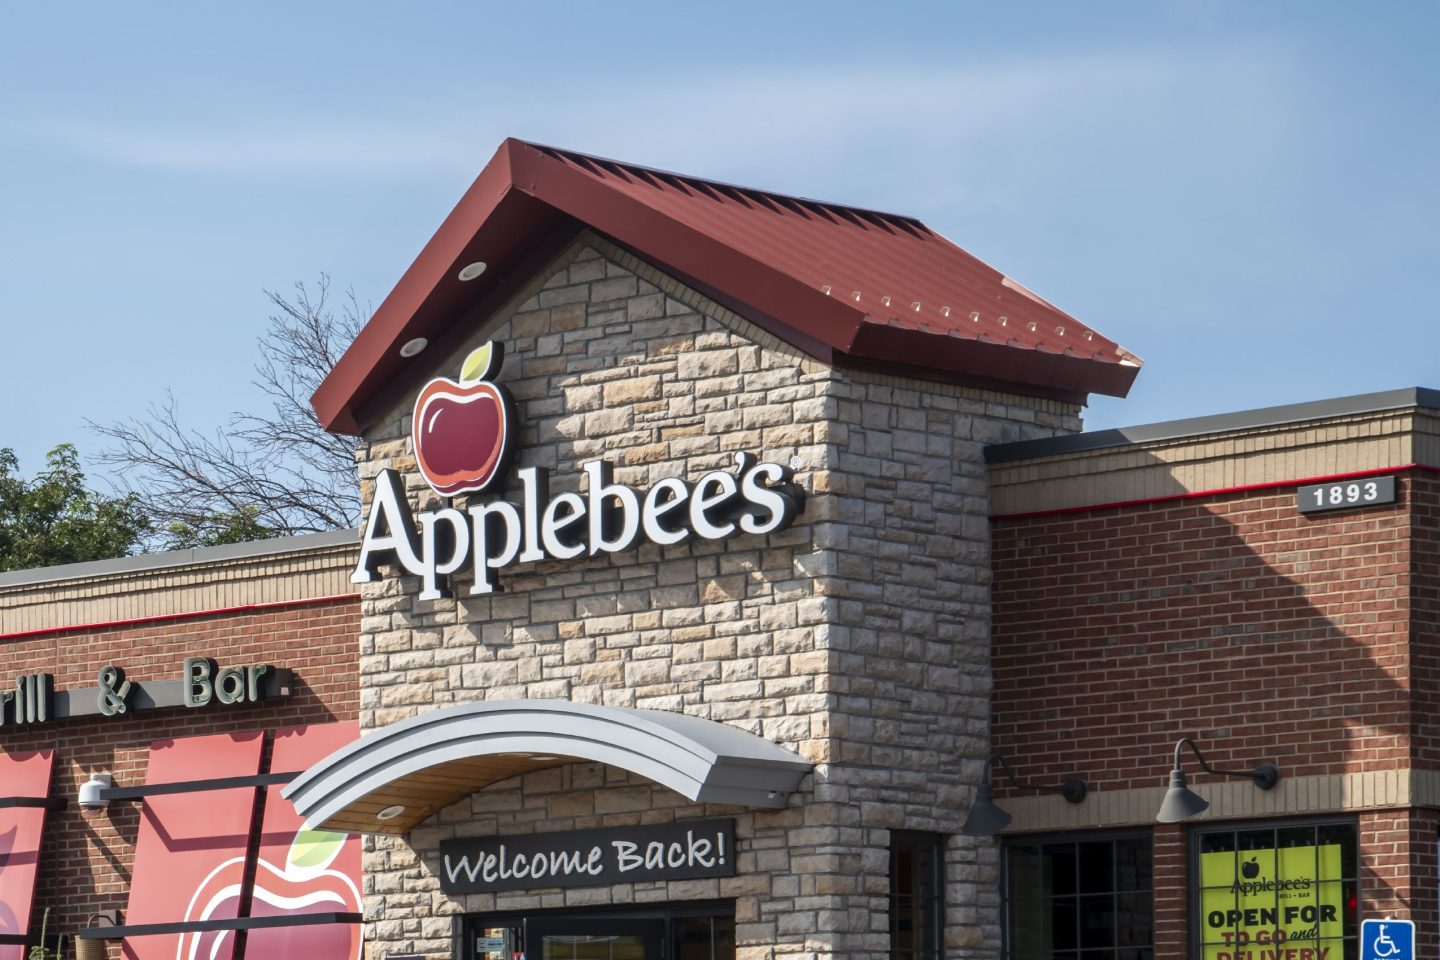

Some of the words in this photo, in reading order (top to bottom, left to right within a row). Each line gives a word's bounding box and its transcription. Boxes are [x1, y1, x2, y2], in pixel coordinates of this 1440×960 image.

[1313, 482, 1378, 506] 1893
[350, 451, 786, 600] Applebee's
[98, 665, 131, 716] &
[184, 656, 267, 707] Bar
[444, 844, 603, 884] Welcome
[611, 830, 726, 873] Back!
[1208, 908, 1277, 928] OPEN
[1284, 904, 1337, 925] FOR
[1221, 931, 1250, 947] TO
[1256, 929, 1287, 946] GO
[1290, 922, 1318, 941] and
